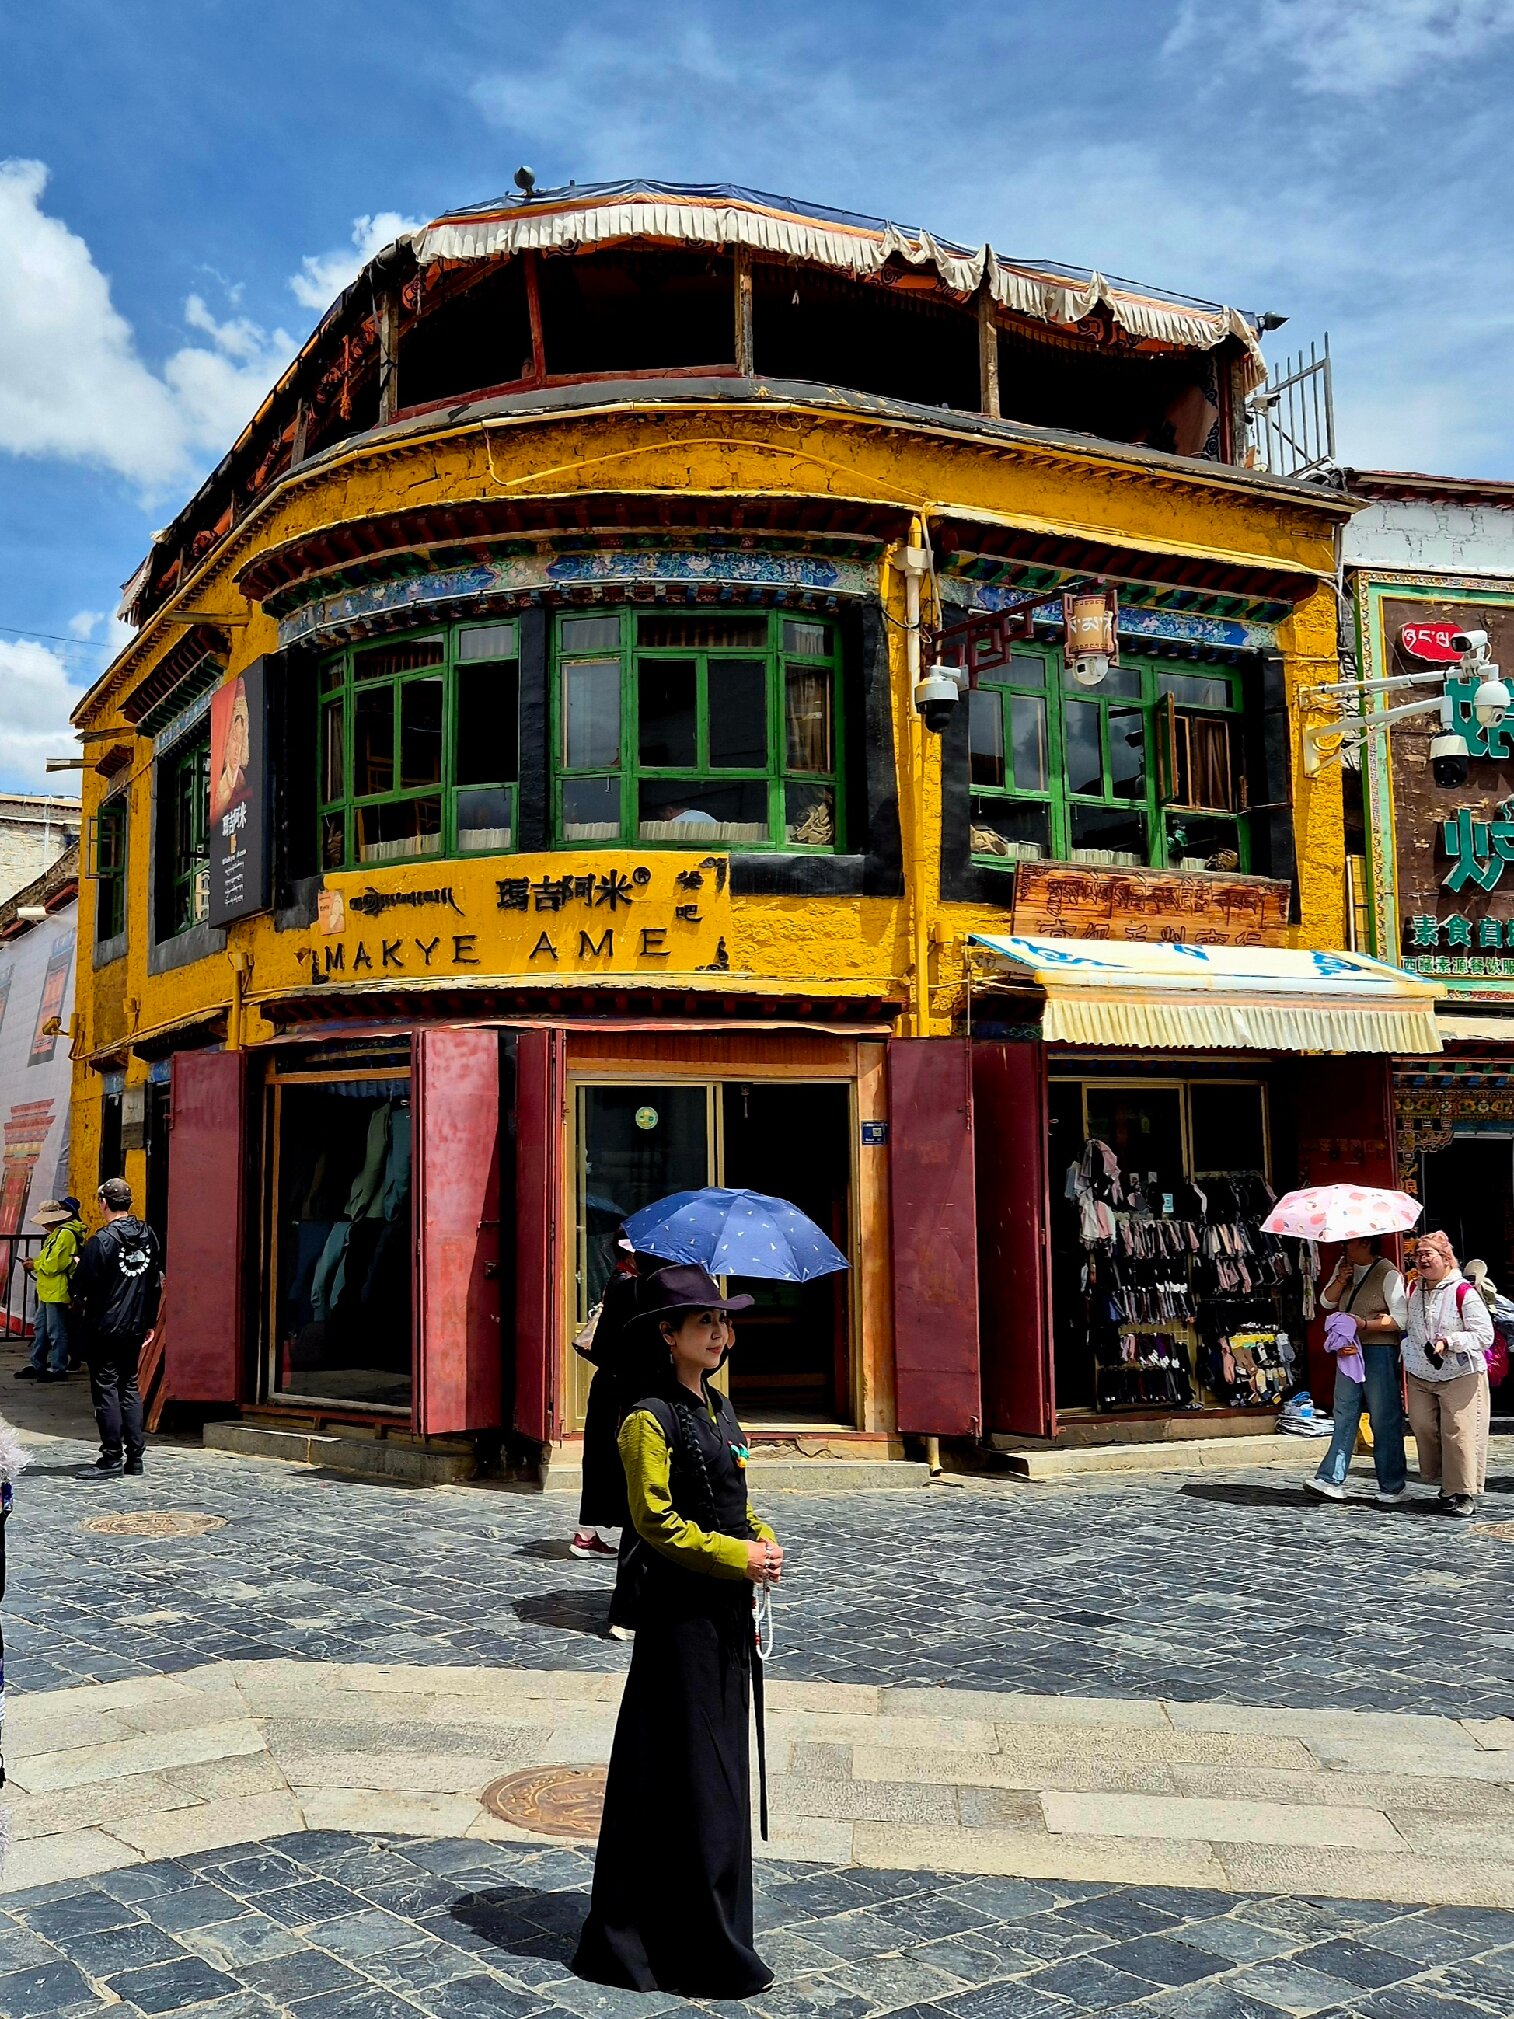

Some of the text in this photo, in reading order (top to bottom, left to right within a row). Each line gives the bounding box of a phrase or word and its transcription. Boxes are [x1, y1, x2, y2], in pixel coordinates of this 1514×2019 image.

[324, 928, 672, 972] MAKYE AME
[1408, 914, 1514, 948] 素食自
